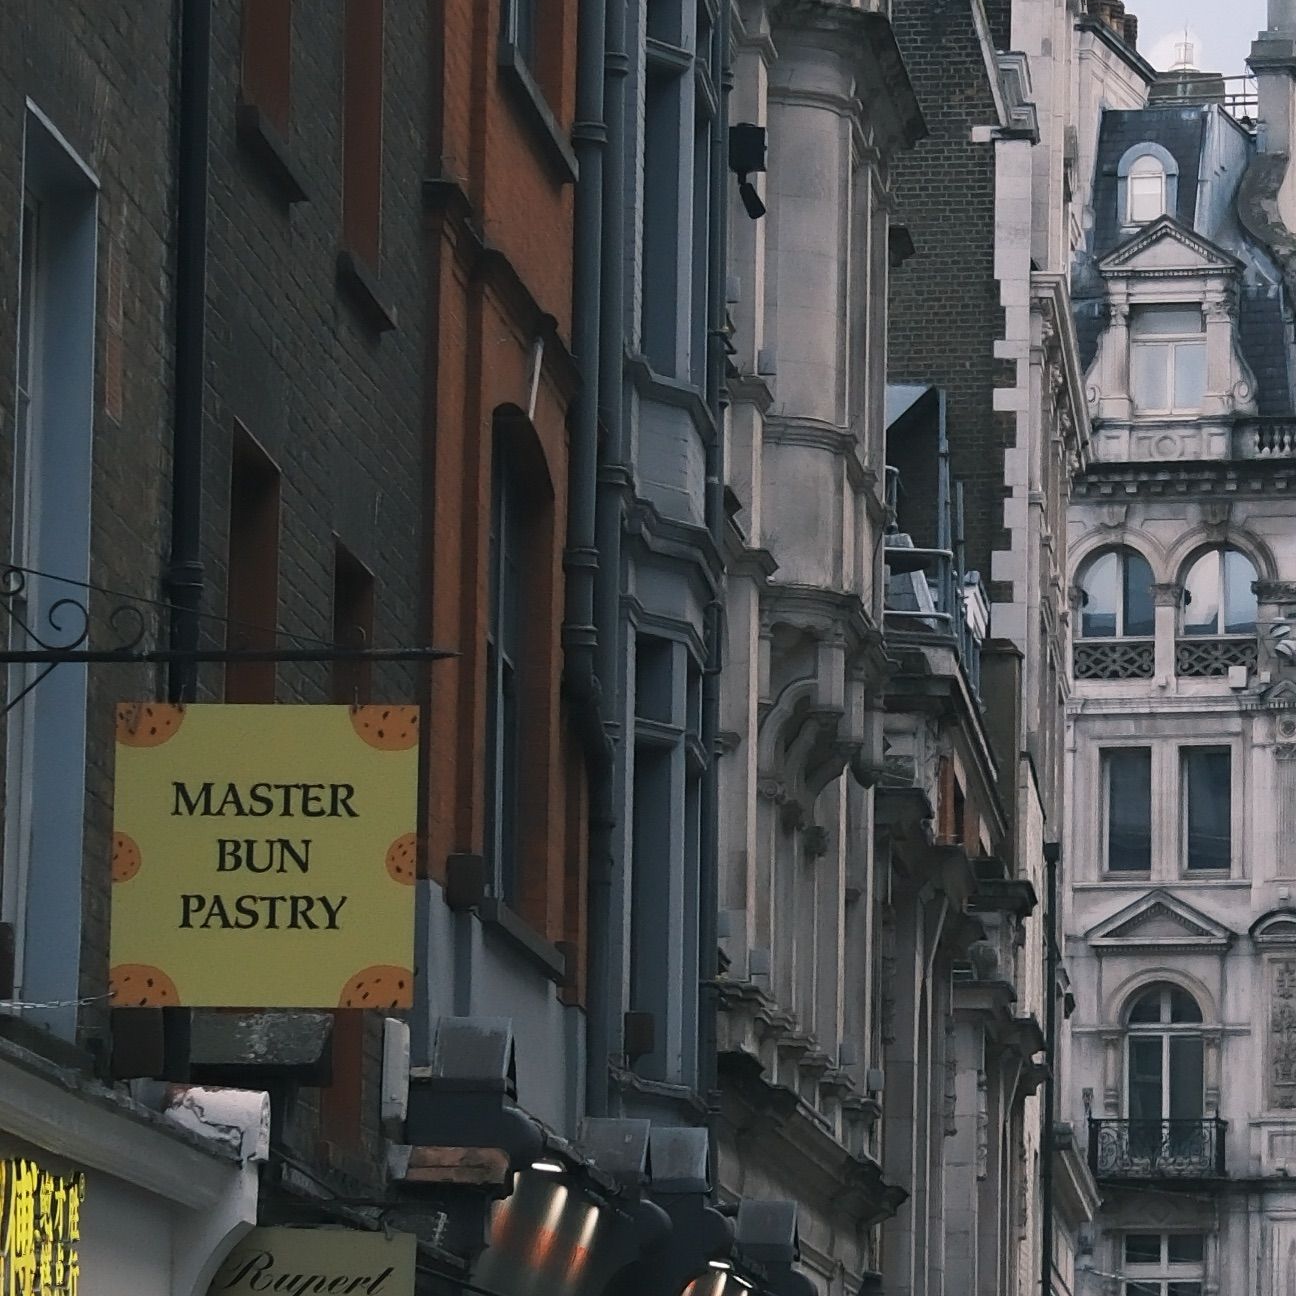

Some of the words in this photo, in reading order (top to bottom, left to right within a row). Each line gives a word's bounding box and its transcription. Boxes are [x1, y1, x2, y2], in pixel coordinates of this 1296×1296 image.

[171, 781, 359, 817] MASTER
[216, 838, 312, 874] BUN
[178, 894, 348, 930] PASTRY
